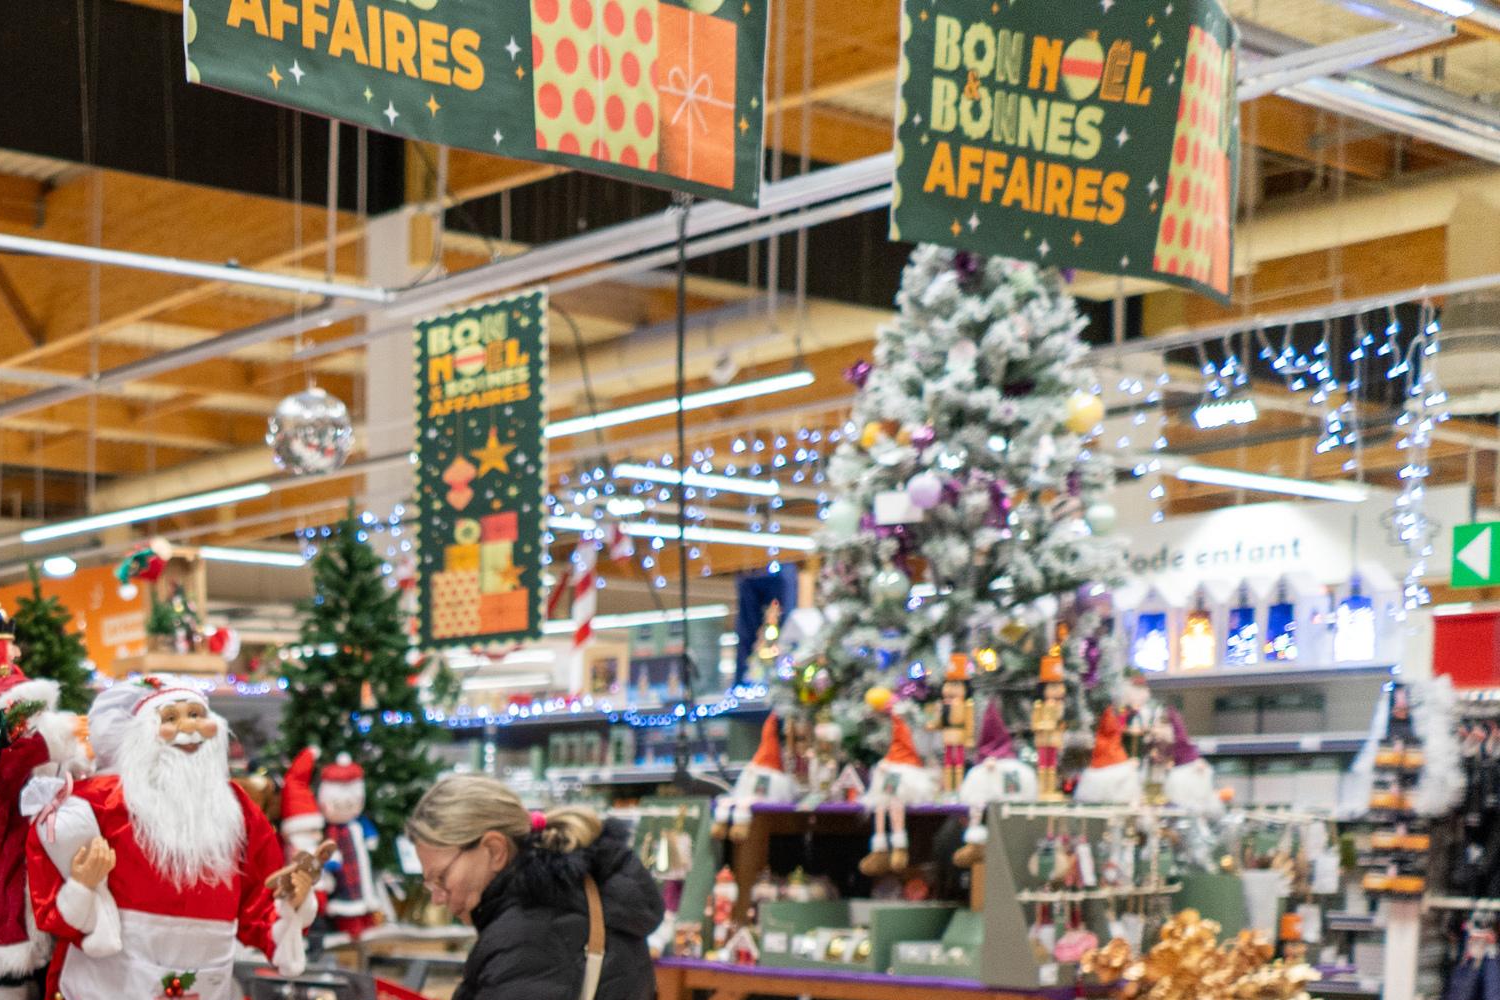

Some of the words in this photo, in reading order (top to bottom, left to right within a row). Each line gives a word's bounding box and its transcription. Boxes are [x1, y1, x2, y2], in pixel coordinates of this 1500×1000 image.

[226, 0, 485, 91] AFFAIRES
[933, 14, 1025, 85] BON
[963, 68, 981, 100] &
[930, 75, 1106, 161] BONNES
[922, 140, 1130, 225] AFFAIRES
[427, 310, 508, 357] BON
[427, 382, 531, 419] AFFAIRES
[444, 365, 531, 399] BONNES
[1195, 536, 1300, 566] enfant
